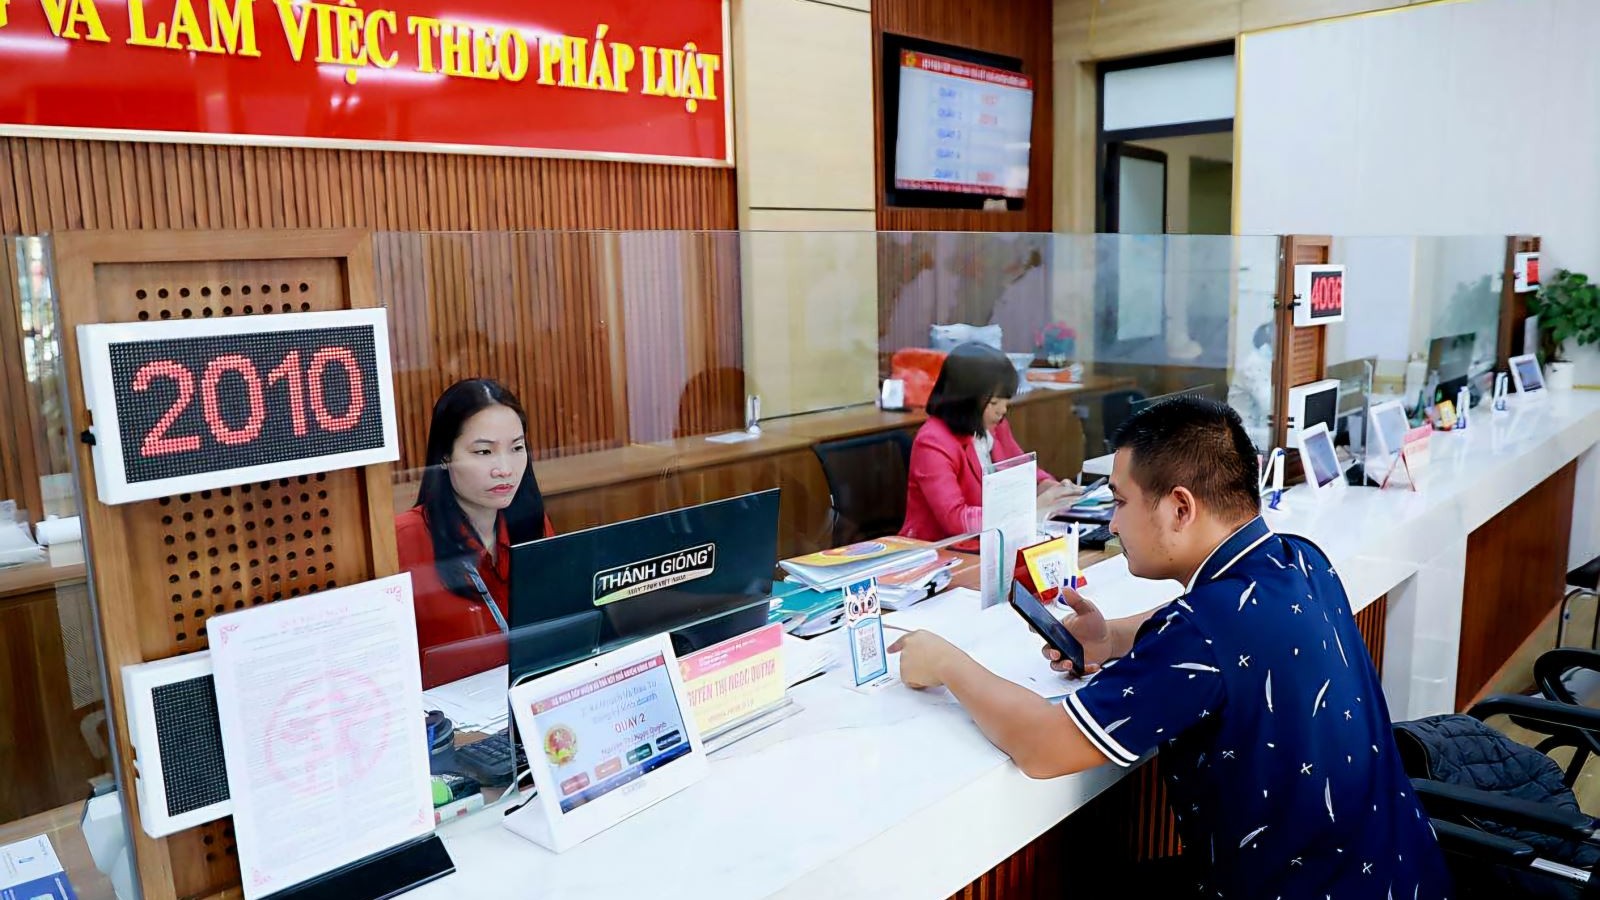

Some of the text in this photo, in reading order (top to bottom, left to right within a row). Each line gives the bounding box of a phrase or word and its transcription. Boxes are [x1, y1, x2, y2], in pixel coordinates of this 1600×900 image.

[407, 15, 529, 82] THEO
[536, 23, 636, 93] PHÁP
[639, 41, 720, 114] LUẬT
[132, 346, 366, 458] 2010
[599, 550, 708, 591] THÁNH GIÓNG
